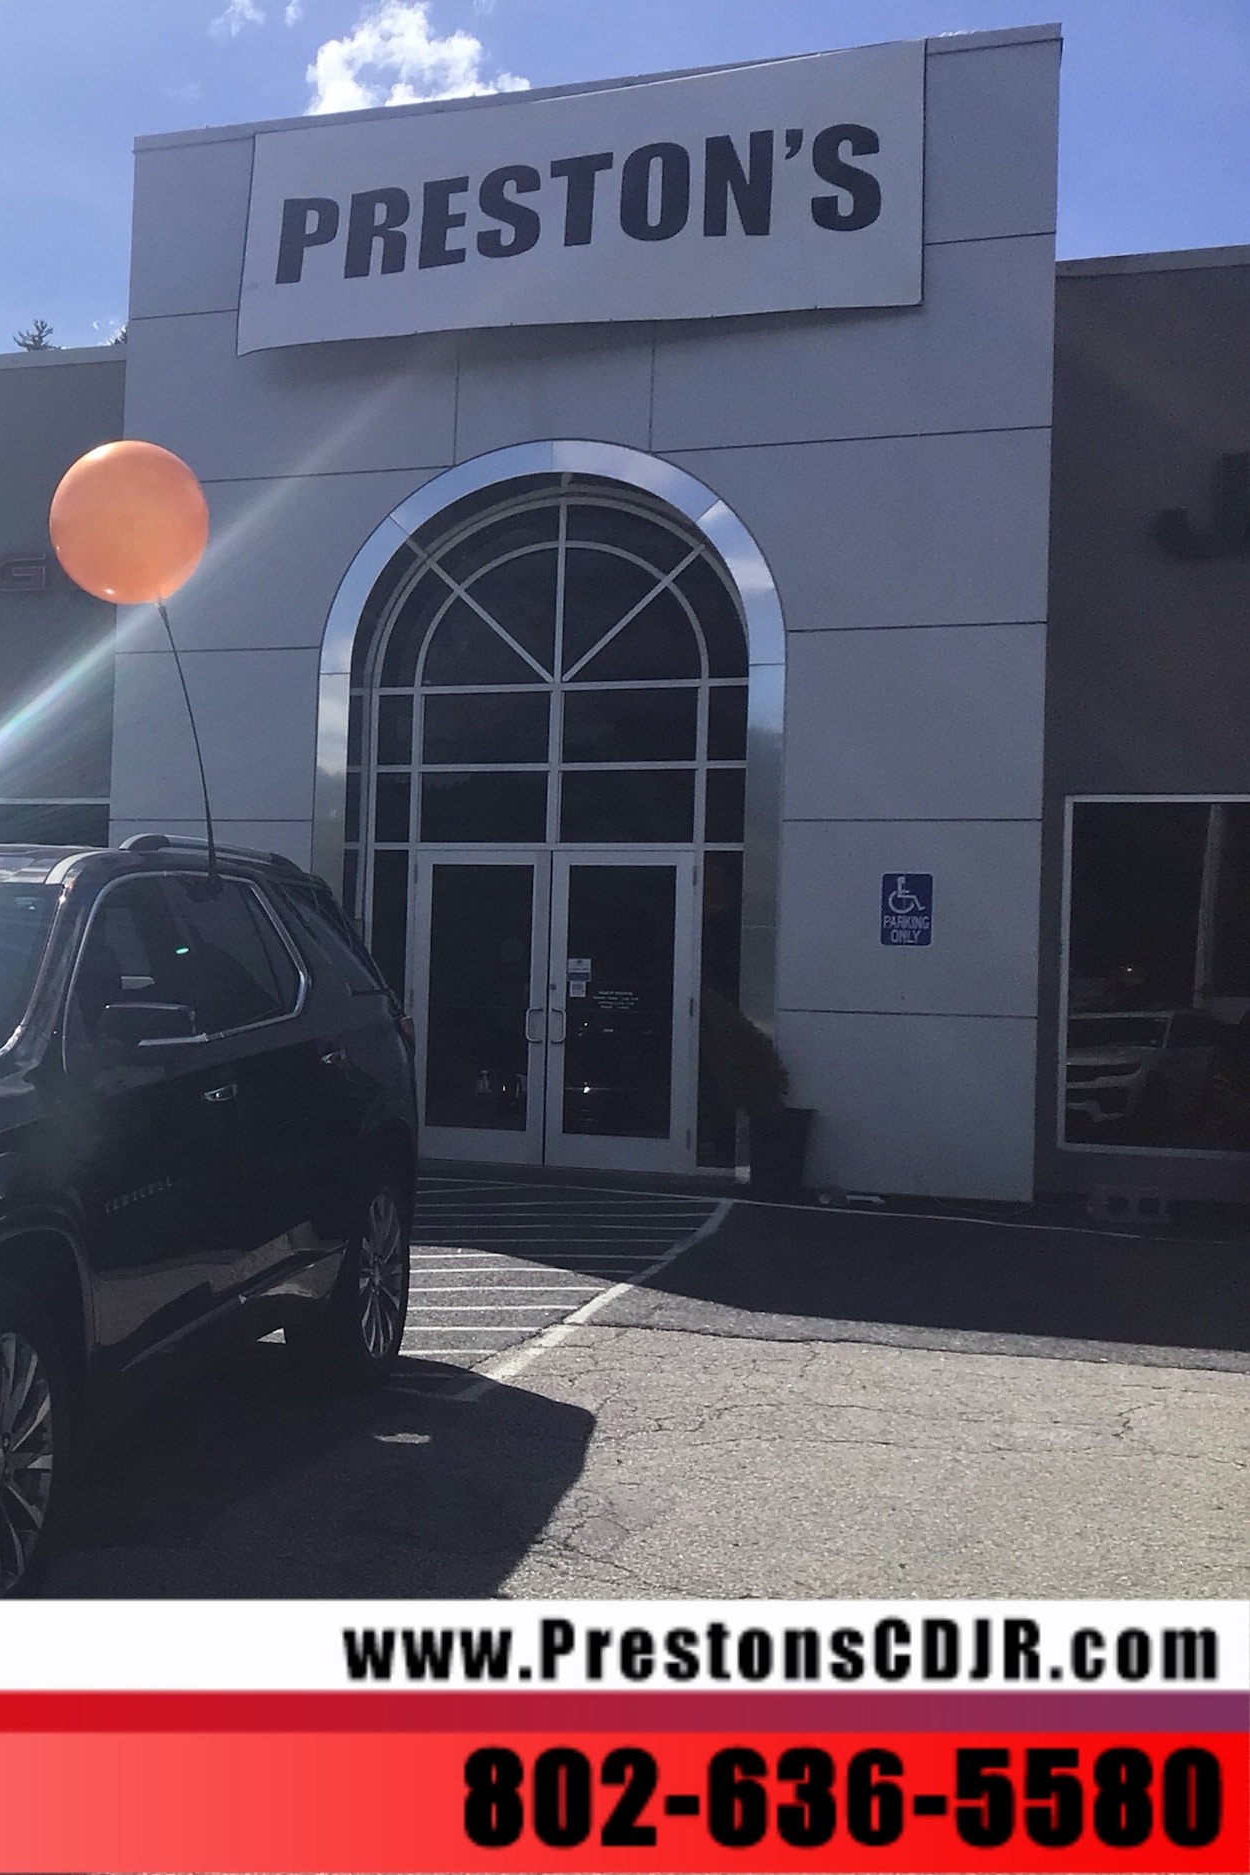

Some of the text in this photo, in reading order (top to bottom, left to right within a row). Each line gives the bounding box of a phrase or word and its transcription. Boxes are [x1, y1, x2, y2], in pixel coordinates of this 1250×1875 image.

[275, 123, 882, 284] PRESTON'S
[883, 915, 930, 929] PARKING
[891, 929, 921, 943] ONLY
